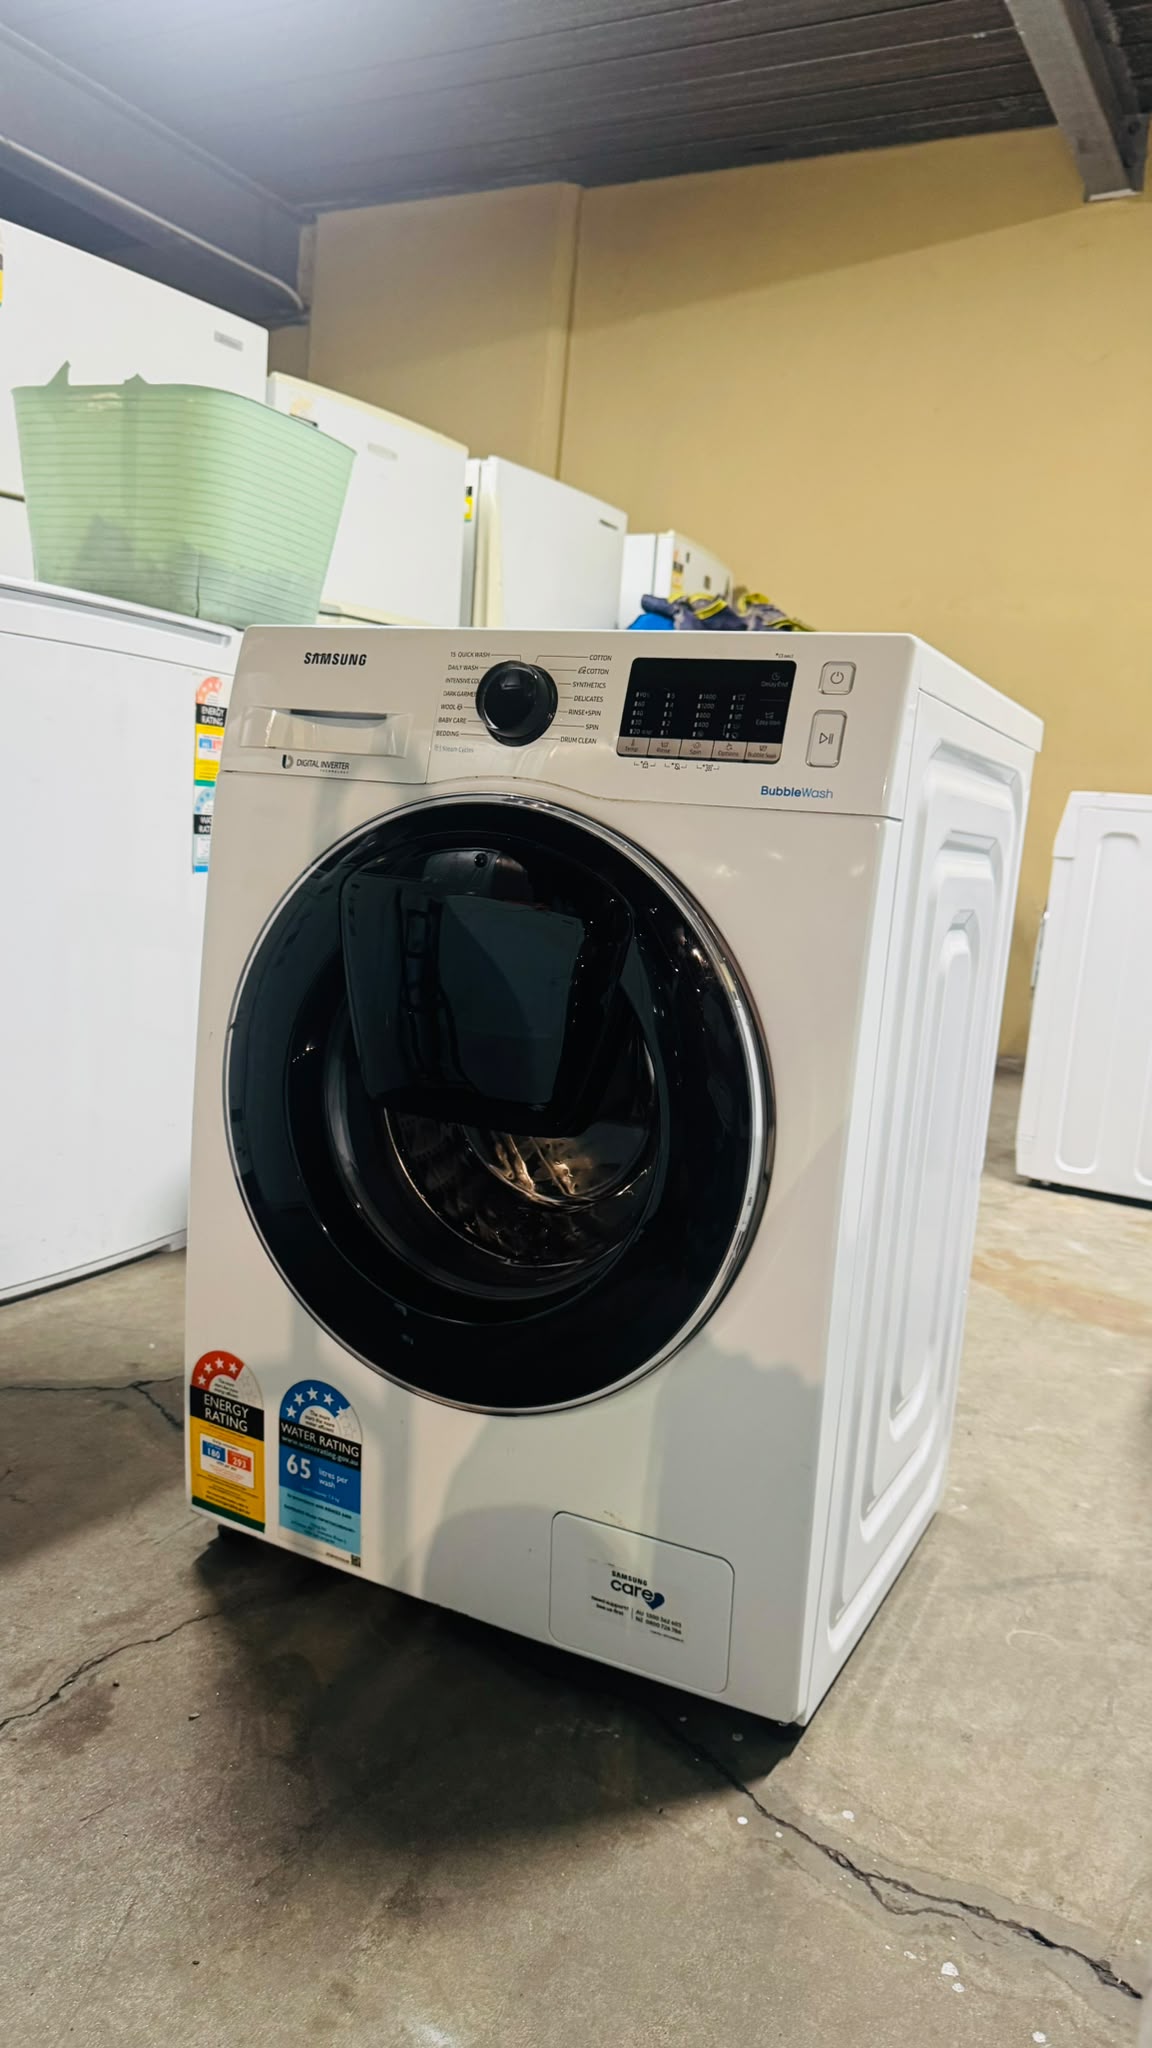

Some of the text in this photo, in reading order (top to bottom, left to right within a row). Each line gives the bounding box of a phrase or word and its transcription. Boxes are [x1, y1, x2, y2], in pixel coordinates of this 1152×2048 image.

[304, 652, 367, 666] SAMSUNG
[560, 736, 577, 744] DRUM
[296, 758, 350, 770] DIGITAL INVERTER
[760, 786, 833, 798] BubbleWash
[204, 1394, 249, 1418] ENERGY
[204, 1408, 248, 1432] RATING
[281, 1422, 360, 1457] WATER RATING
[232, 1457, 247, 1469] 293
[286, 1454, 312, 1479] 65
[319, 1478, 336, 1489] wash
[336, 1475, 349, 1484] per
[611, 1570, 648, 1587] SAMSUNG
[610, 1580, 654, 1601] care
